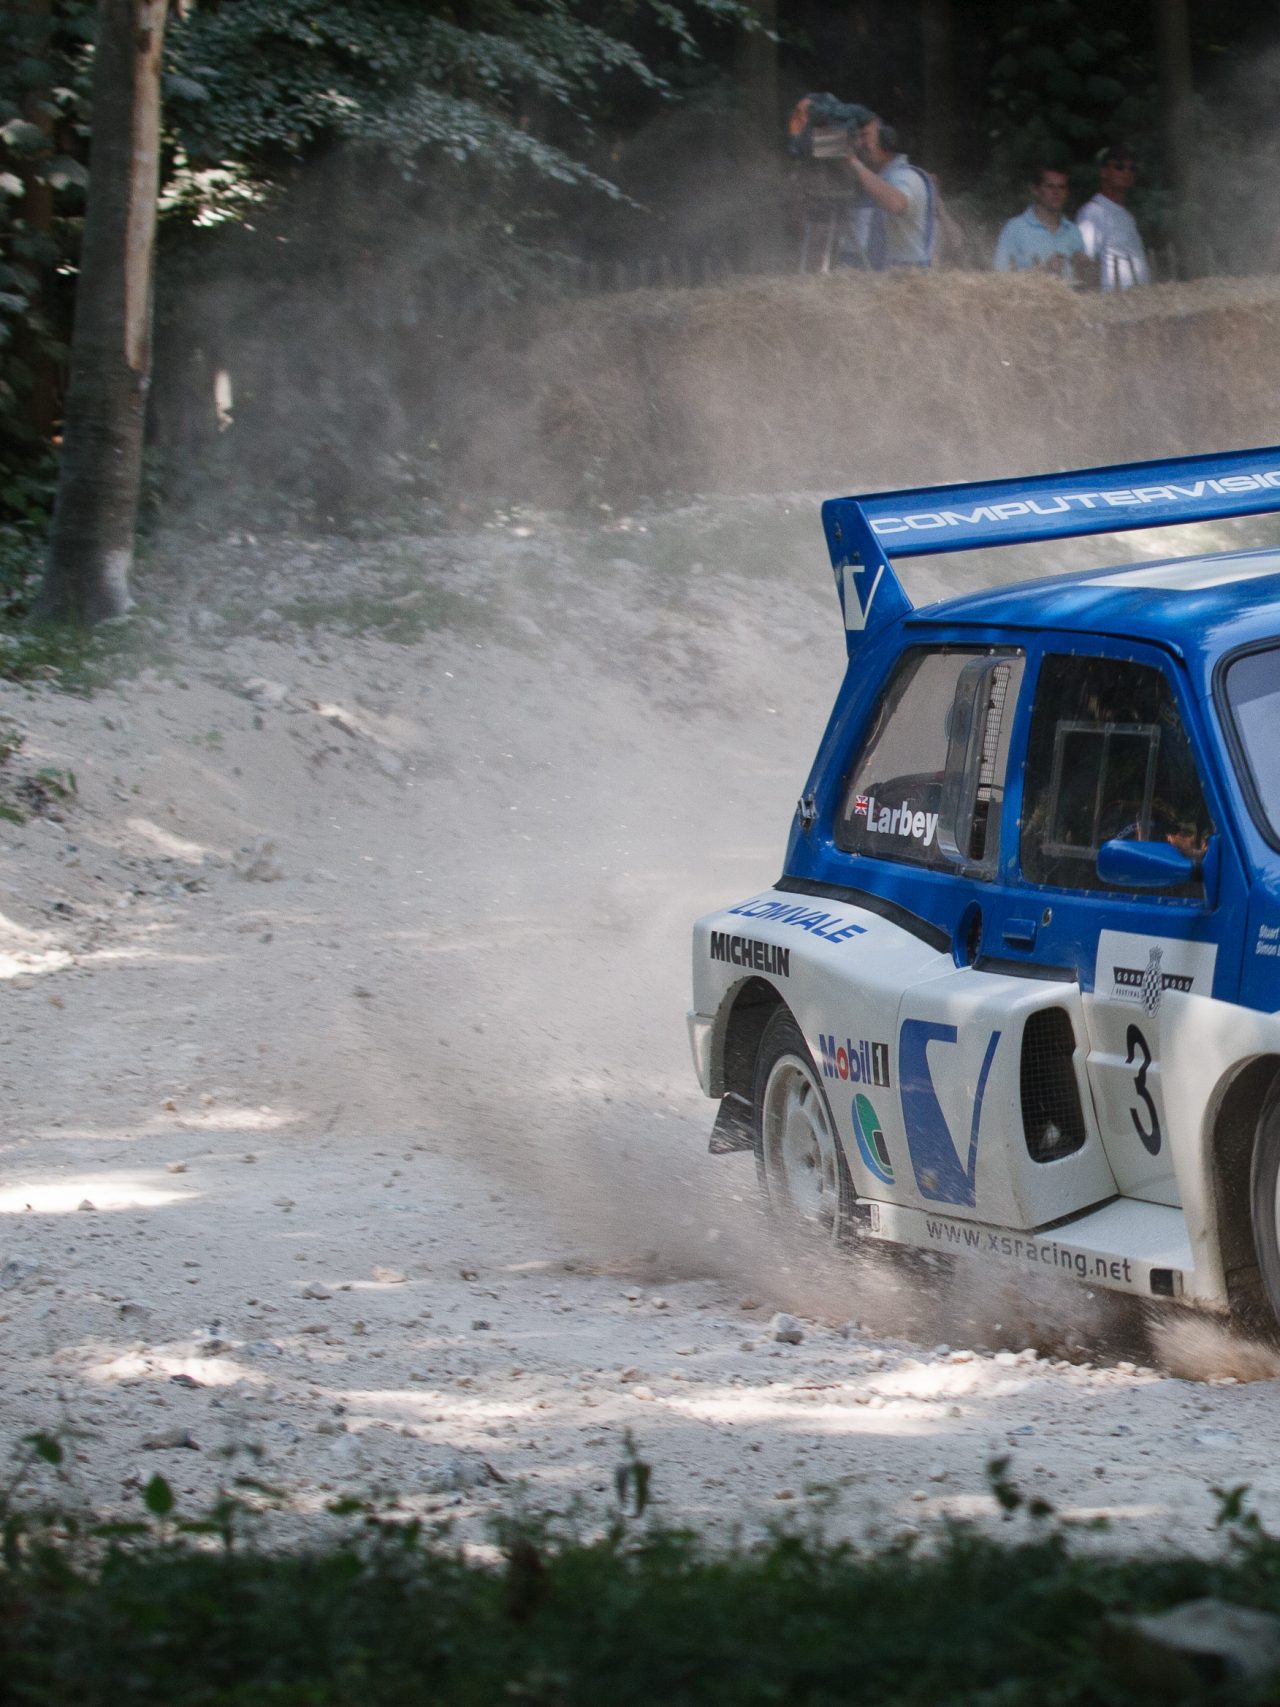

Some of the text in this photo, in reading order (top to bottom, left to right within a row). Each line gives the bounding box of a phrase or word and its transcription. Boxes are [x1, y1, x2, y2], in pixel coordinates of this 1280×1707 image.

[865, 796, 939, 847] Larbey
[709, 930, 791, 978] MICHELIN
[1258, 924, 1280, 940] Stuart
[818, 1033, 872, 1085] Mobil
[1124, 1023, 1162, 1156] 3
[925, 1219, 1133, 1283] www.xsracing.net
